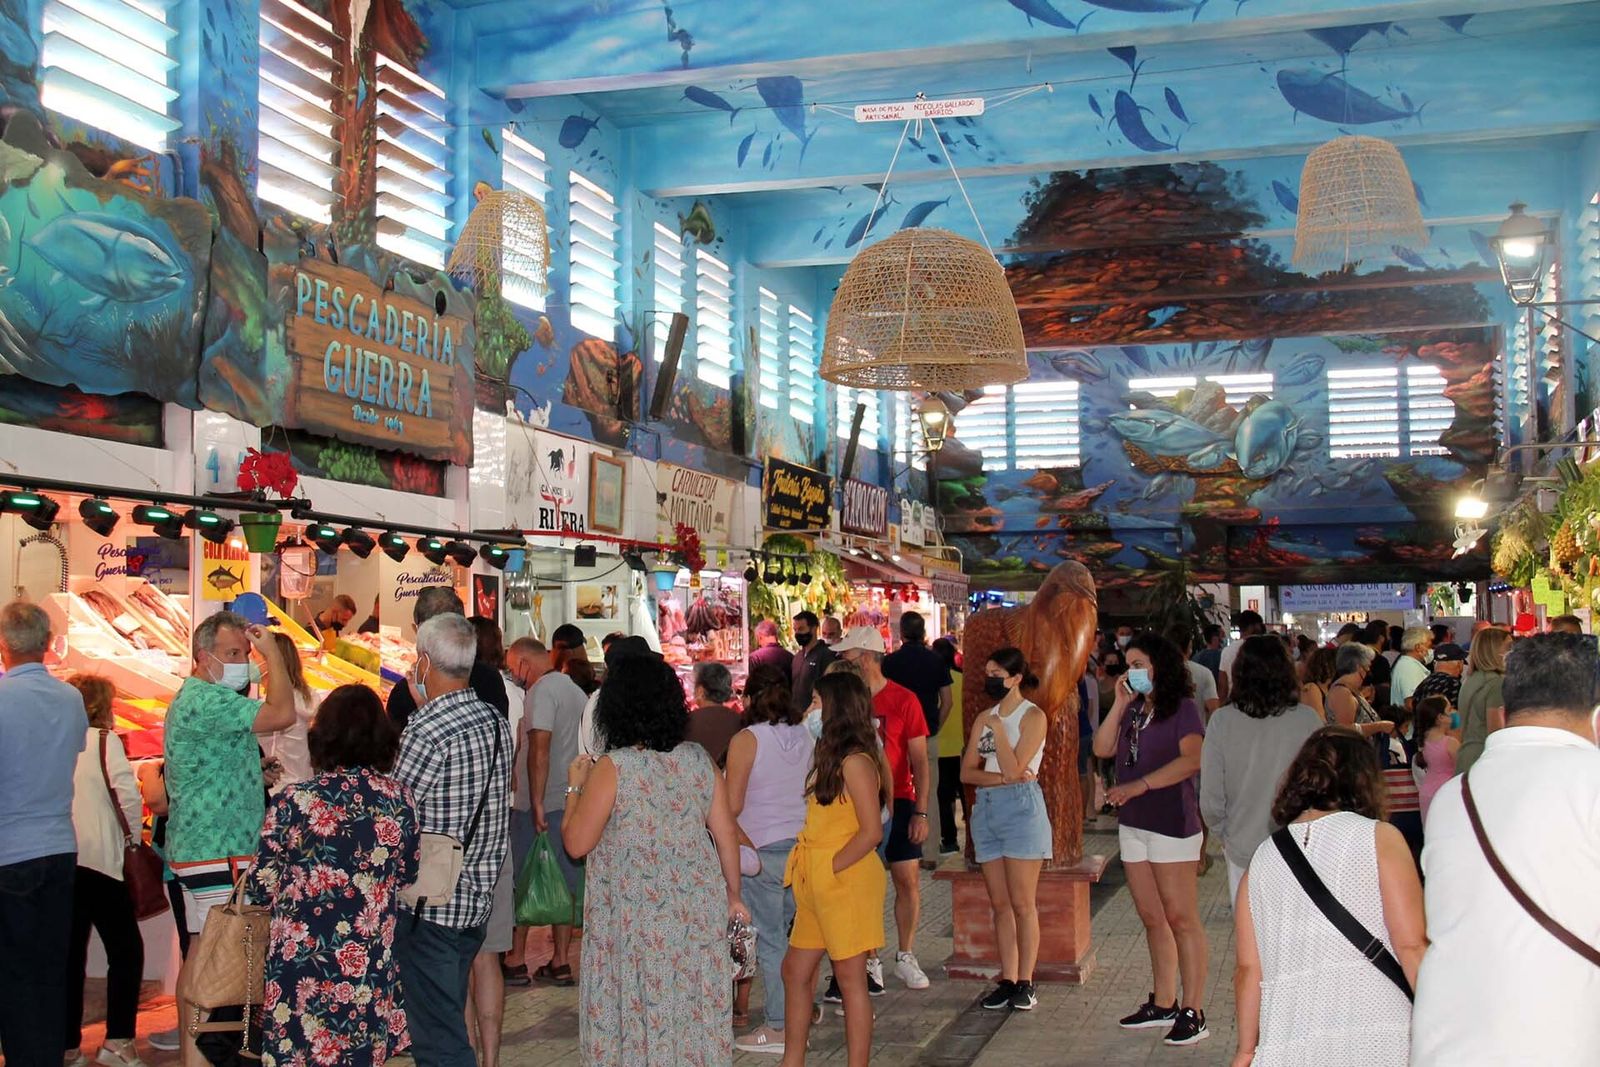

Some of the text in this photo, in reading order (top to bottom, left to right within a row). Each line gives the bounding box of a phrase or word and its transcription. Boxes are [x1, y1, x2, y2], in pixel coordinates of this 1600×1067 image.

[296, 272, 454, 367] PESCADERÍA
[323, 340, 433, 418] GUERRA
[205, 448, 220, 483] 4
[394, 587, 421, 602] Guerr
